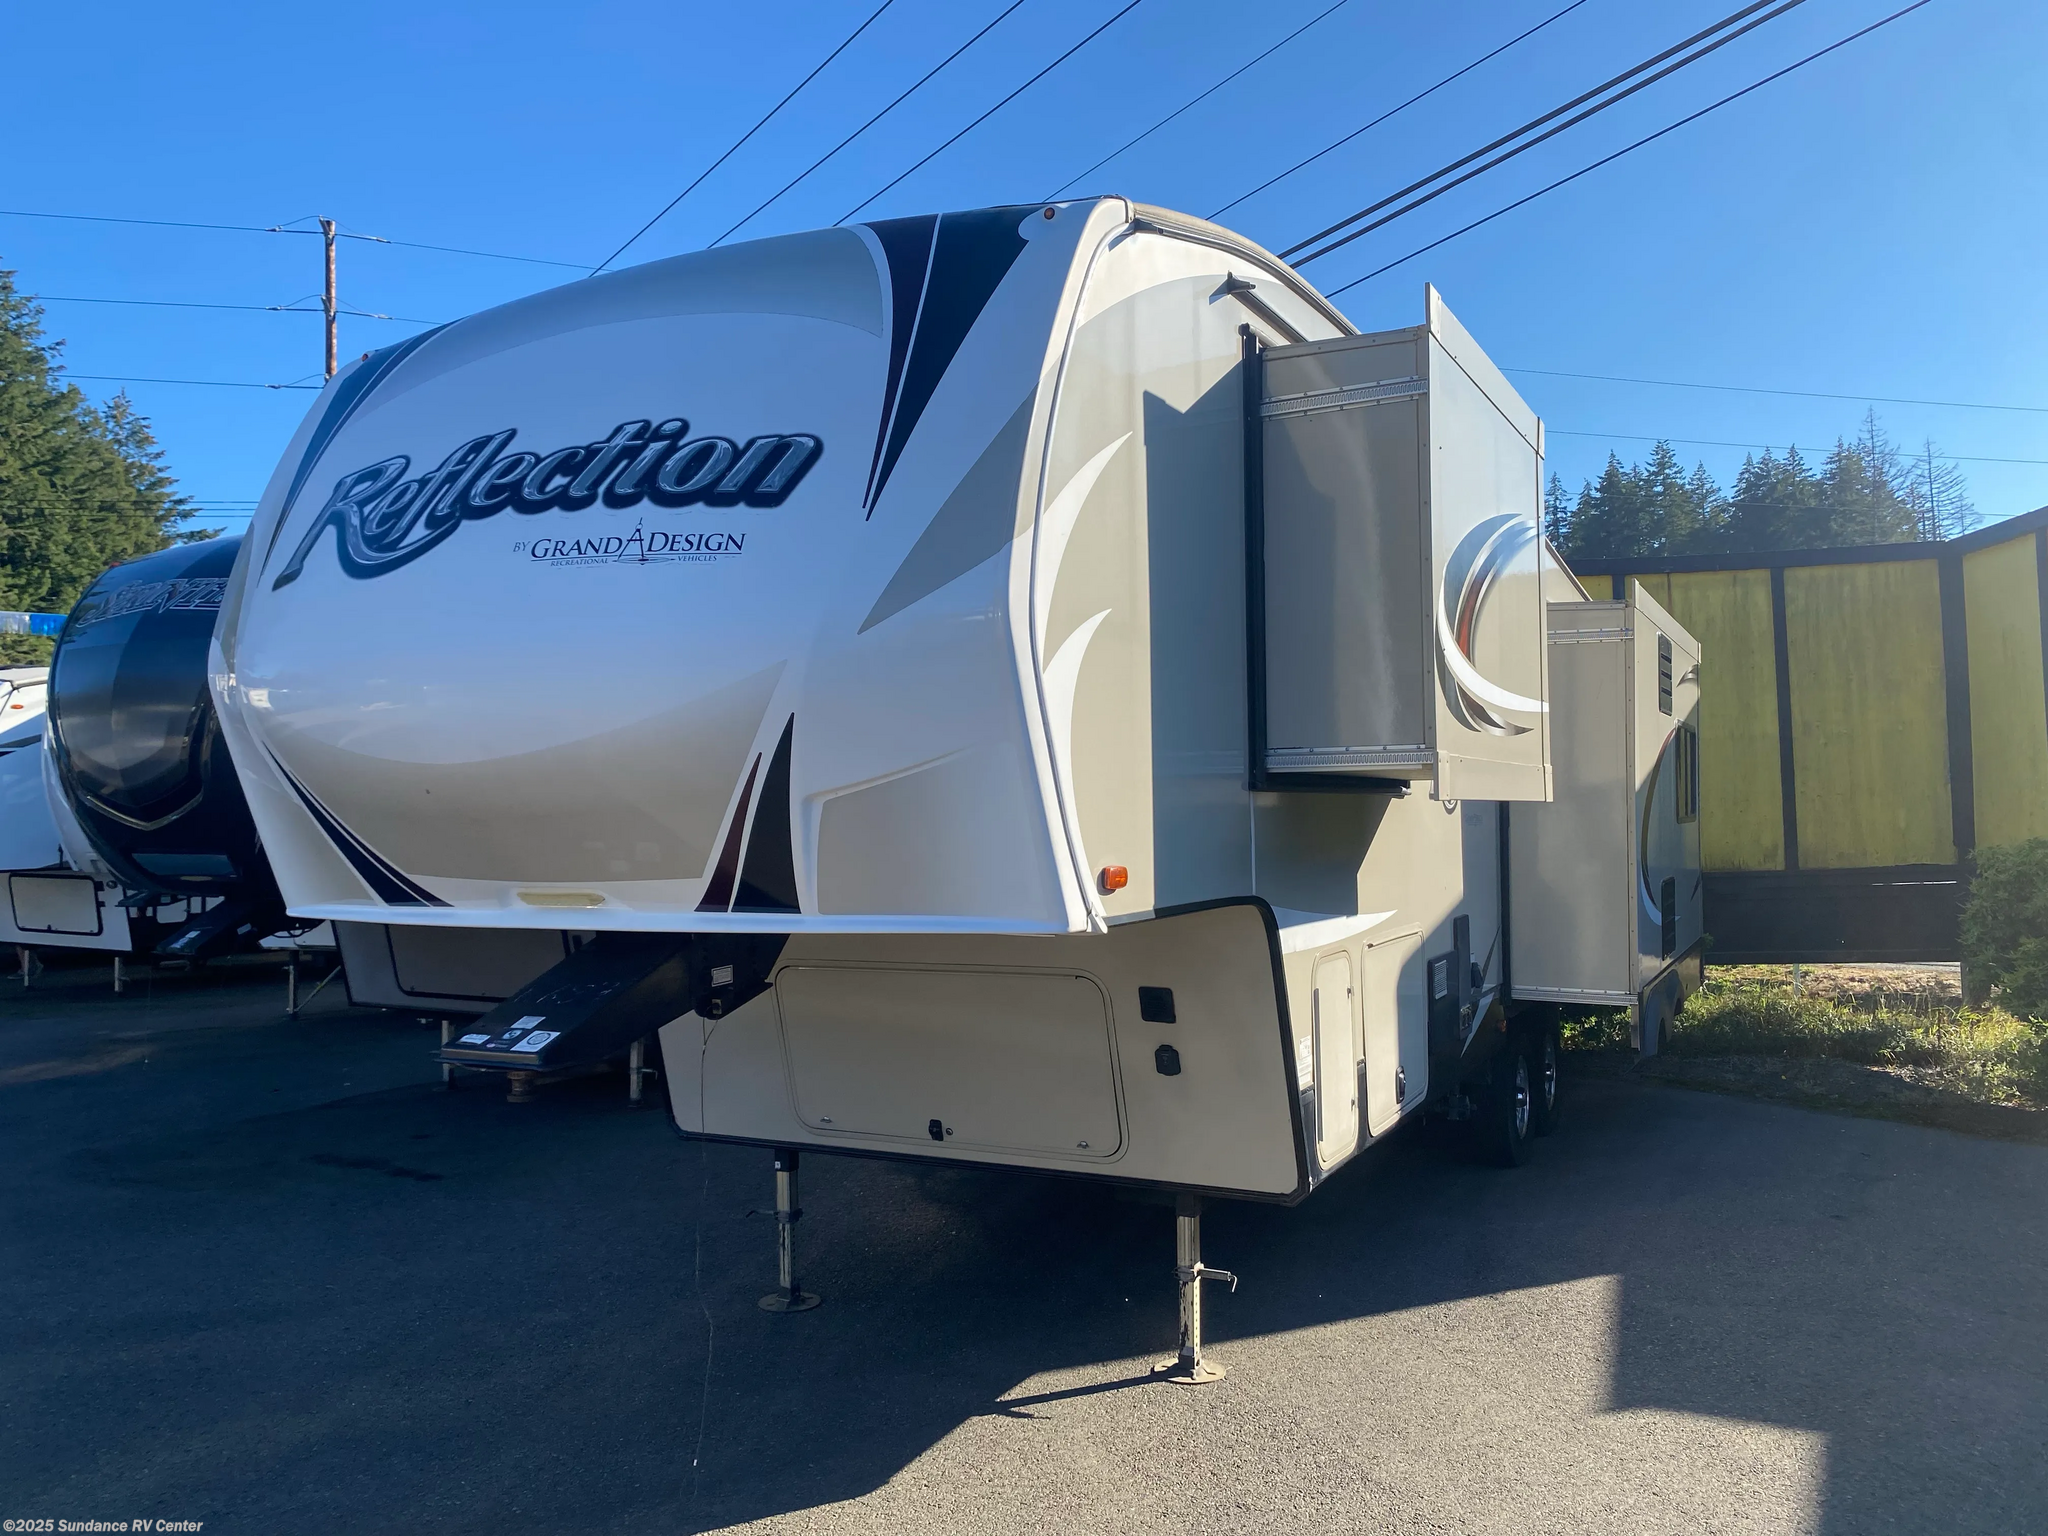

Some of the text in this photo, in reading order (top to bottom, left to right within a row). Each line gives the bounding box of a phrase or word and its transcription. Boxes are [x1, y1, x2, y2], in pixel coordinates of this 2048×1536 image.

[271, 418, 825, 592] Reflection
[513, 531, 746, 559] BY GRAND DESIGN
[550, 555, 717, 567] RECREATIONAL VEHICLES
